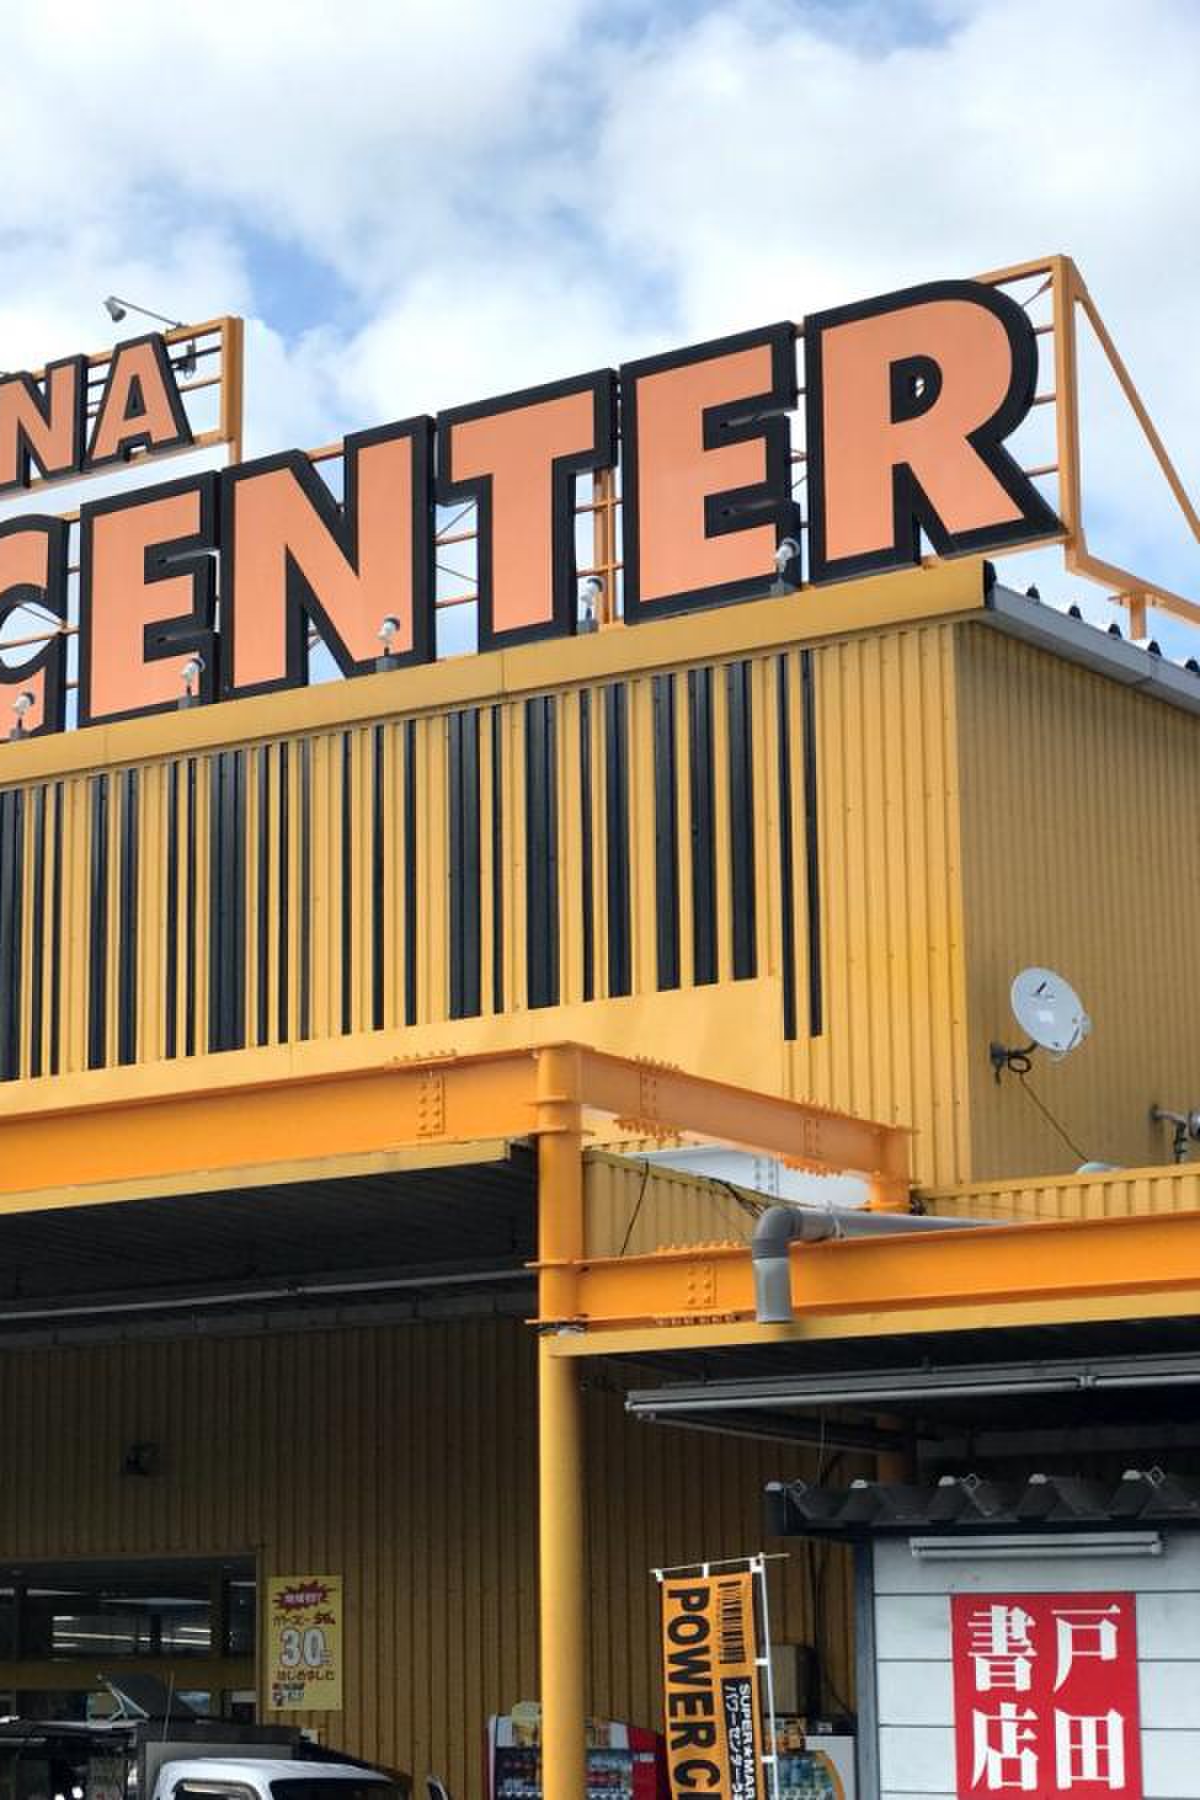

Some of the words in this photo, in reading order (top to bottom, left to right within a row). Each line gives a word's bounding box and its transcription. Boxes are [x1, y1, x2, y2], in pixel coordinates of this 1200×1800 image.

[667, 1586, 717, 1751] POWER
[967, 1604, 1039, 1790] 書店
[1051, 1604, 1125, 1790] 戸田
[672, 1758, 723, 1800] C
